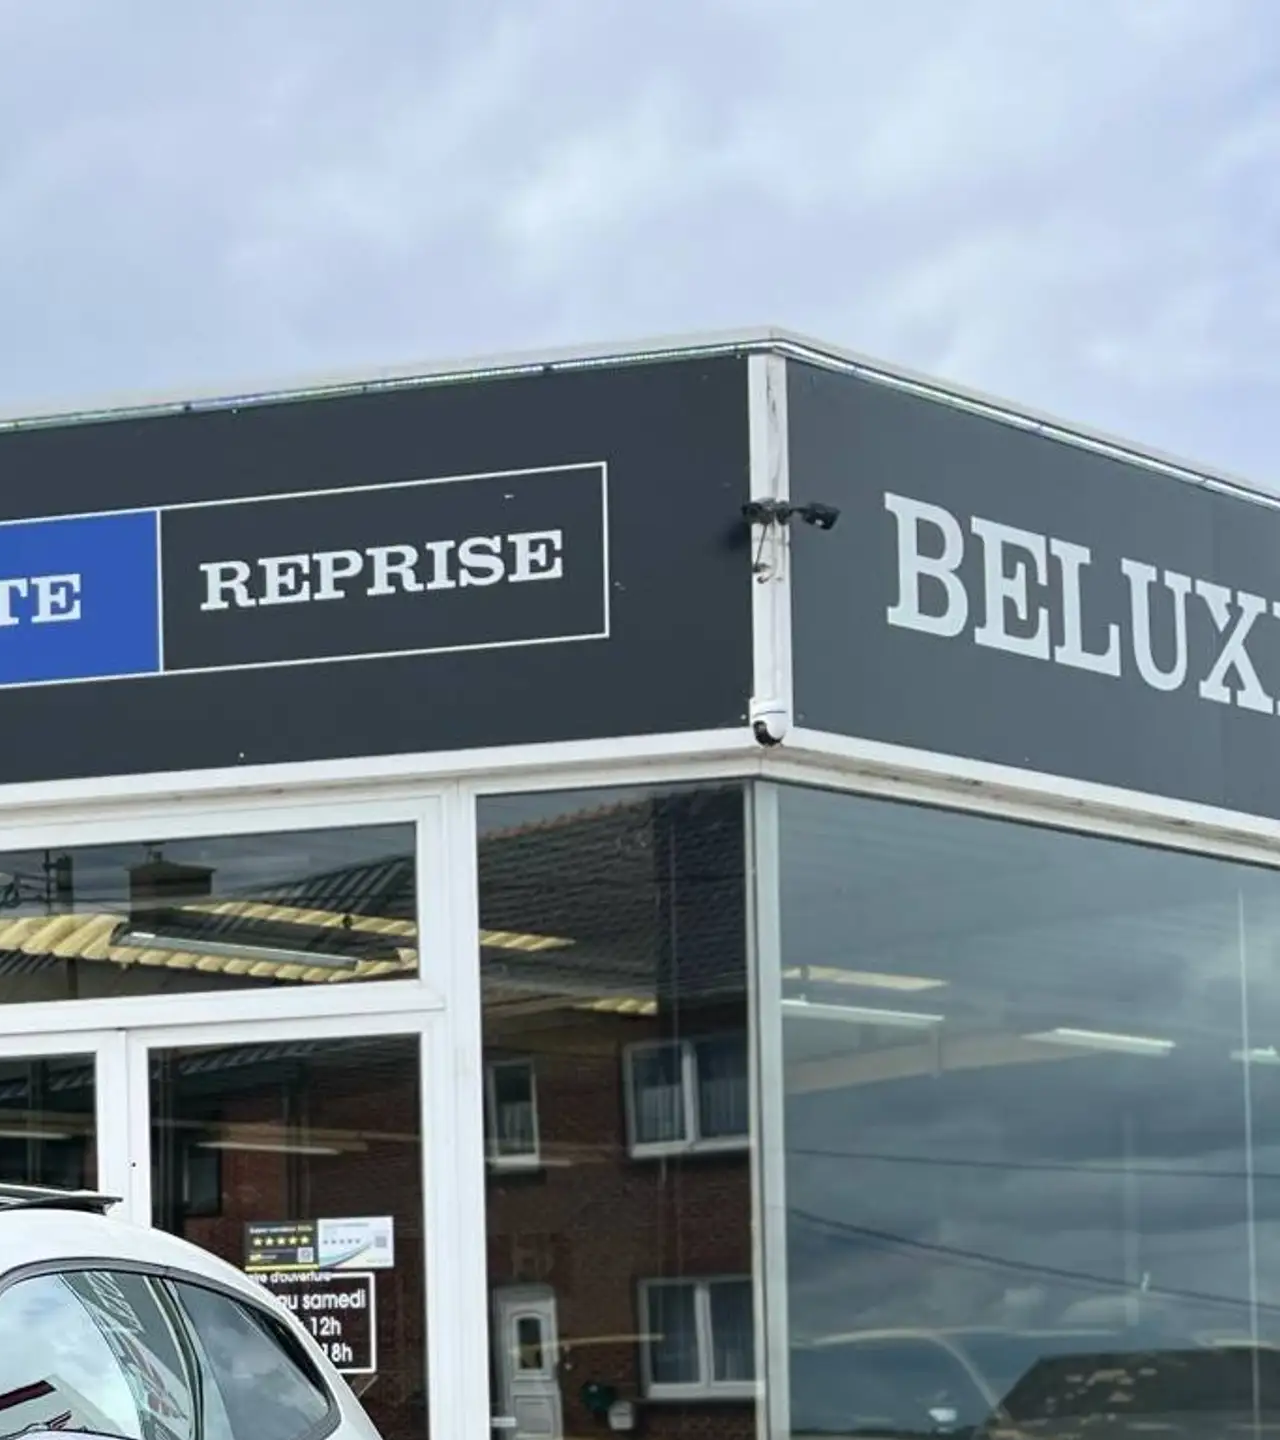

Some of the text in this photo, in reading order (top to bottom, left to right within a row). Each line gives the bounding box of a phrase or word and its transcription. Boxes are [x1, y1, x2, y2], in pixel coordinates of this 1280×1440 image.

[199, 529, 563, 611] REPRISE
[884, 492, 1280, 716] BELUX
[302, 1288, 367, 1310] samedi
[310, 1316, 342, 1336] 12h
[321, 1343, 354, 1362] 18h
